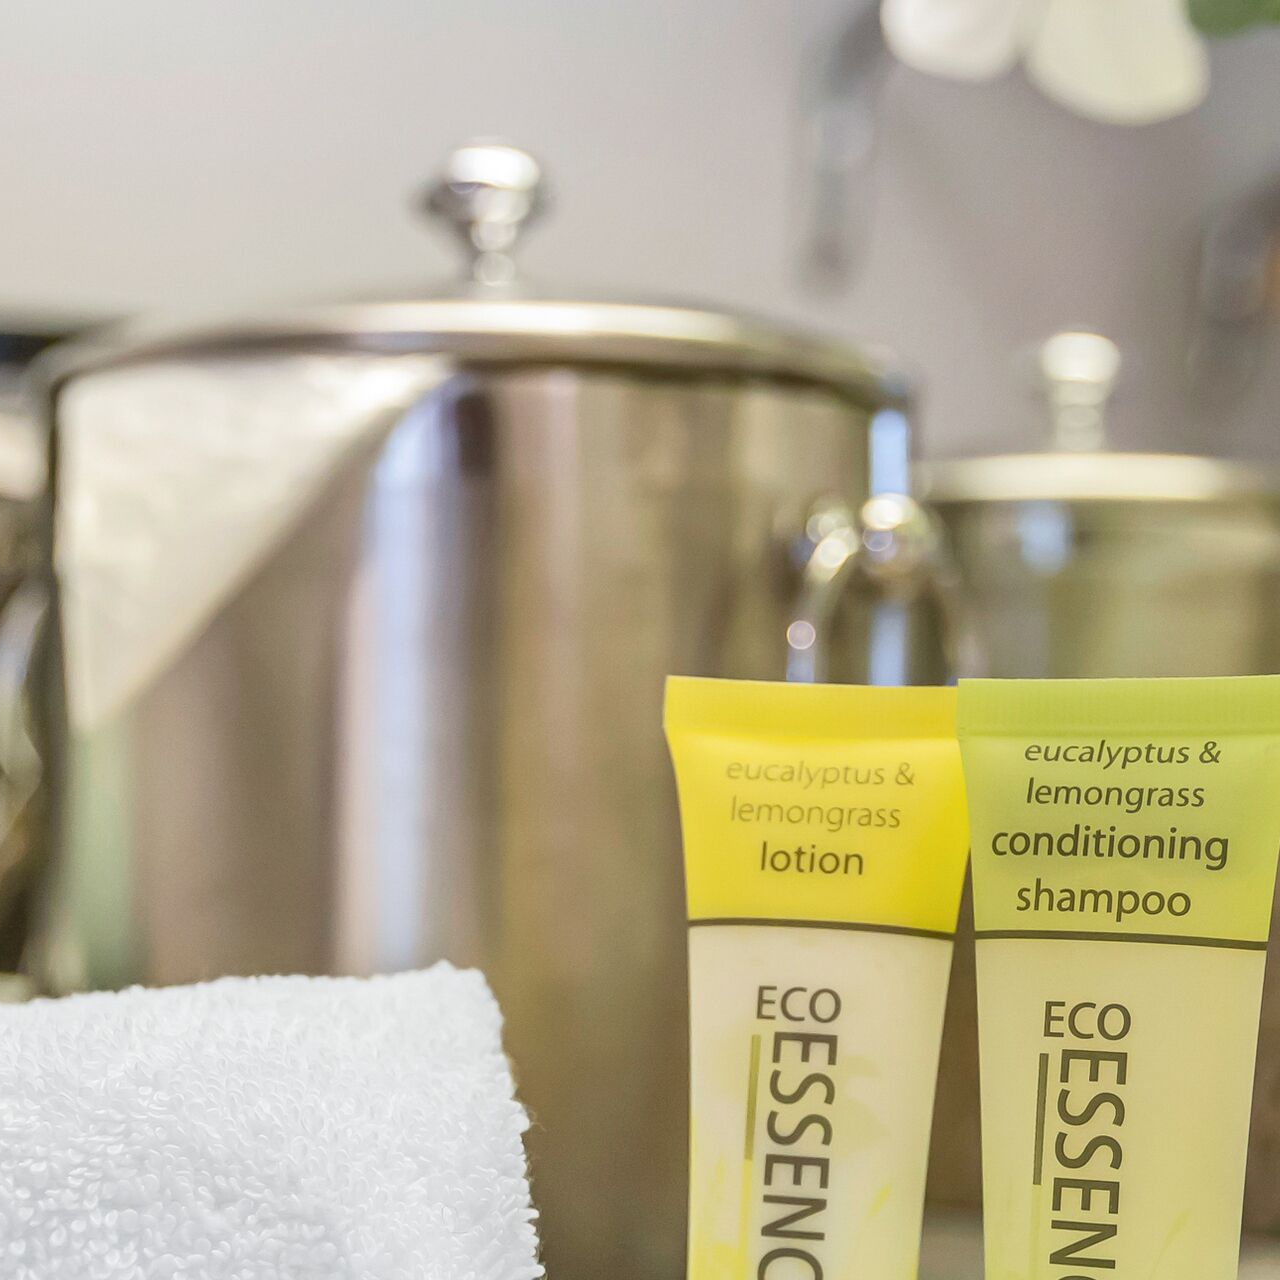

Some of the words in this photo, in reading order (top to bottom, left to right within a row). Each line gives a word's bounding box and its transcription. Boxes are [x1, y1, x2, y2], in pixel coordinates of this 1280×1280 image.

[1024, 740, 1190, 770] eucalyptus
[1198, 741, 1222, 764] &
[725, 758, 885, 791] eucalyptus
[894, 762, 916, 787] &
[1026, 777, 1205, 813] lemongrass
[730, 796, 901, 833] lemongrass
[759, 841, 864, 876] lotion
[991, 824, 1229, 871] conditioning
[1016, 878, 1192, 923] shampoo
[756, 985, 842, 1024] ECO
[1043, 1001, 1132, 1041] ECO
